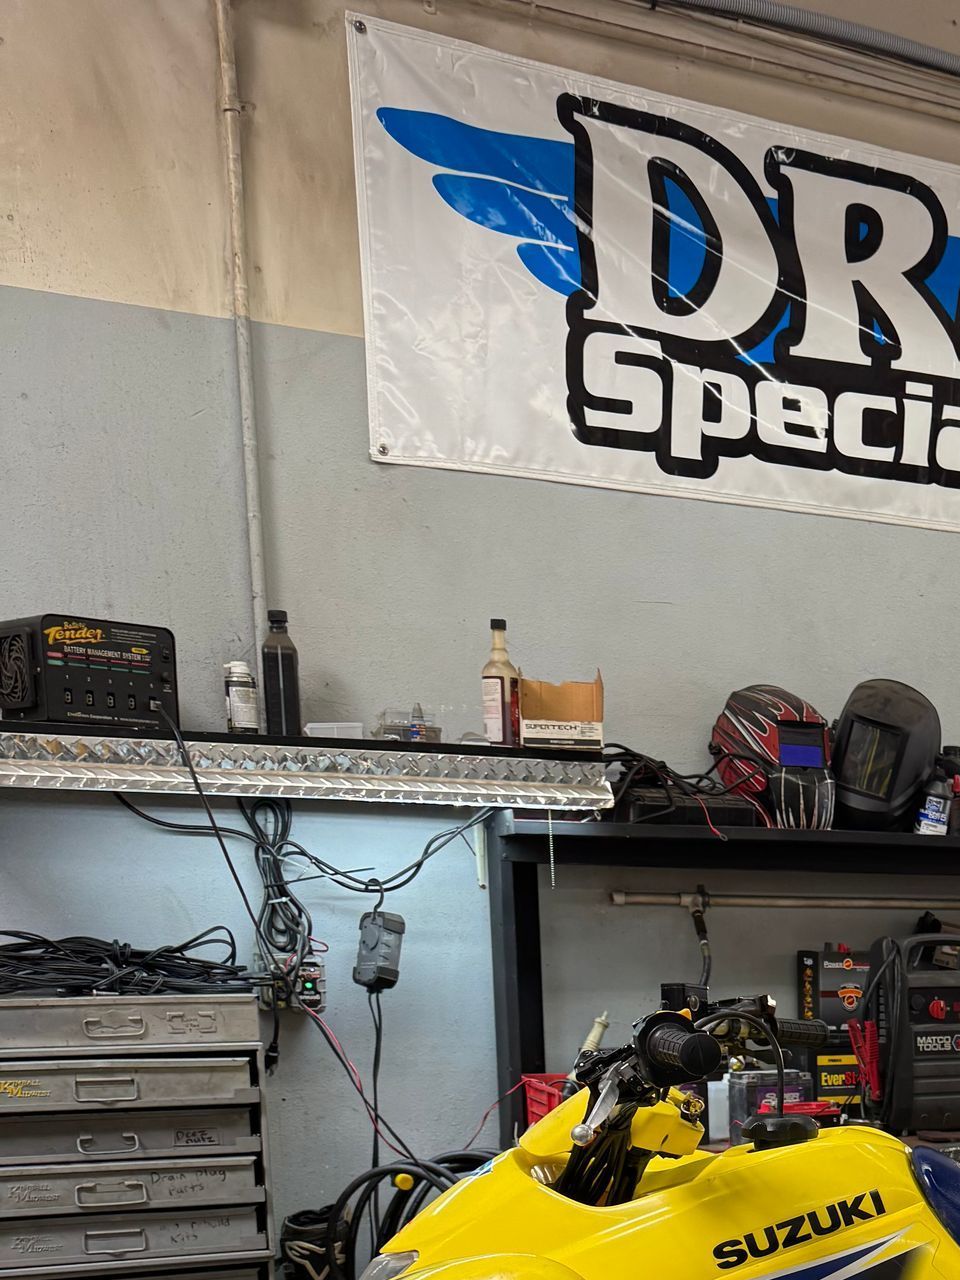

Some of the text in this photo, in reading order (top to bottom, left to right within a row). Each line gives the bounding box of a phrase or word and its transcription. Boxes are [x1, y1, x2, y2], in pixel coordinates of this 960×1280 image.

[43, 626, 103, 645] Tender
[63, 645, 86, 654] BATTERY
[87, 648, 121, 659] MANAGEMENT
[122, 652, 142, 661] SYSTEM
[917, 1036, 951, 1044] MATCO
[917, 1043, 951, 1052] TOOLS
[151, 1172, 186, 1184] Drain
[712, 1188, 887, 1270] SUZUKI
